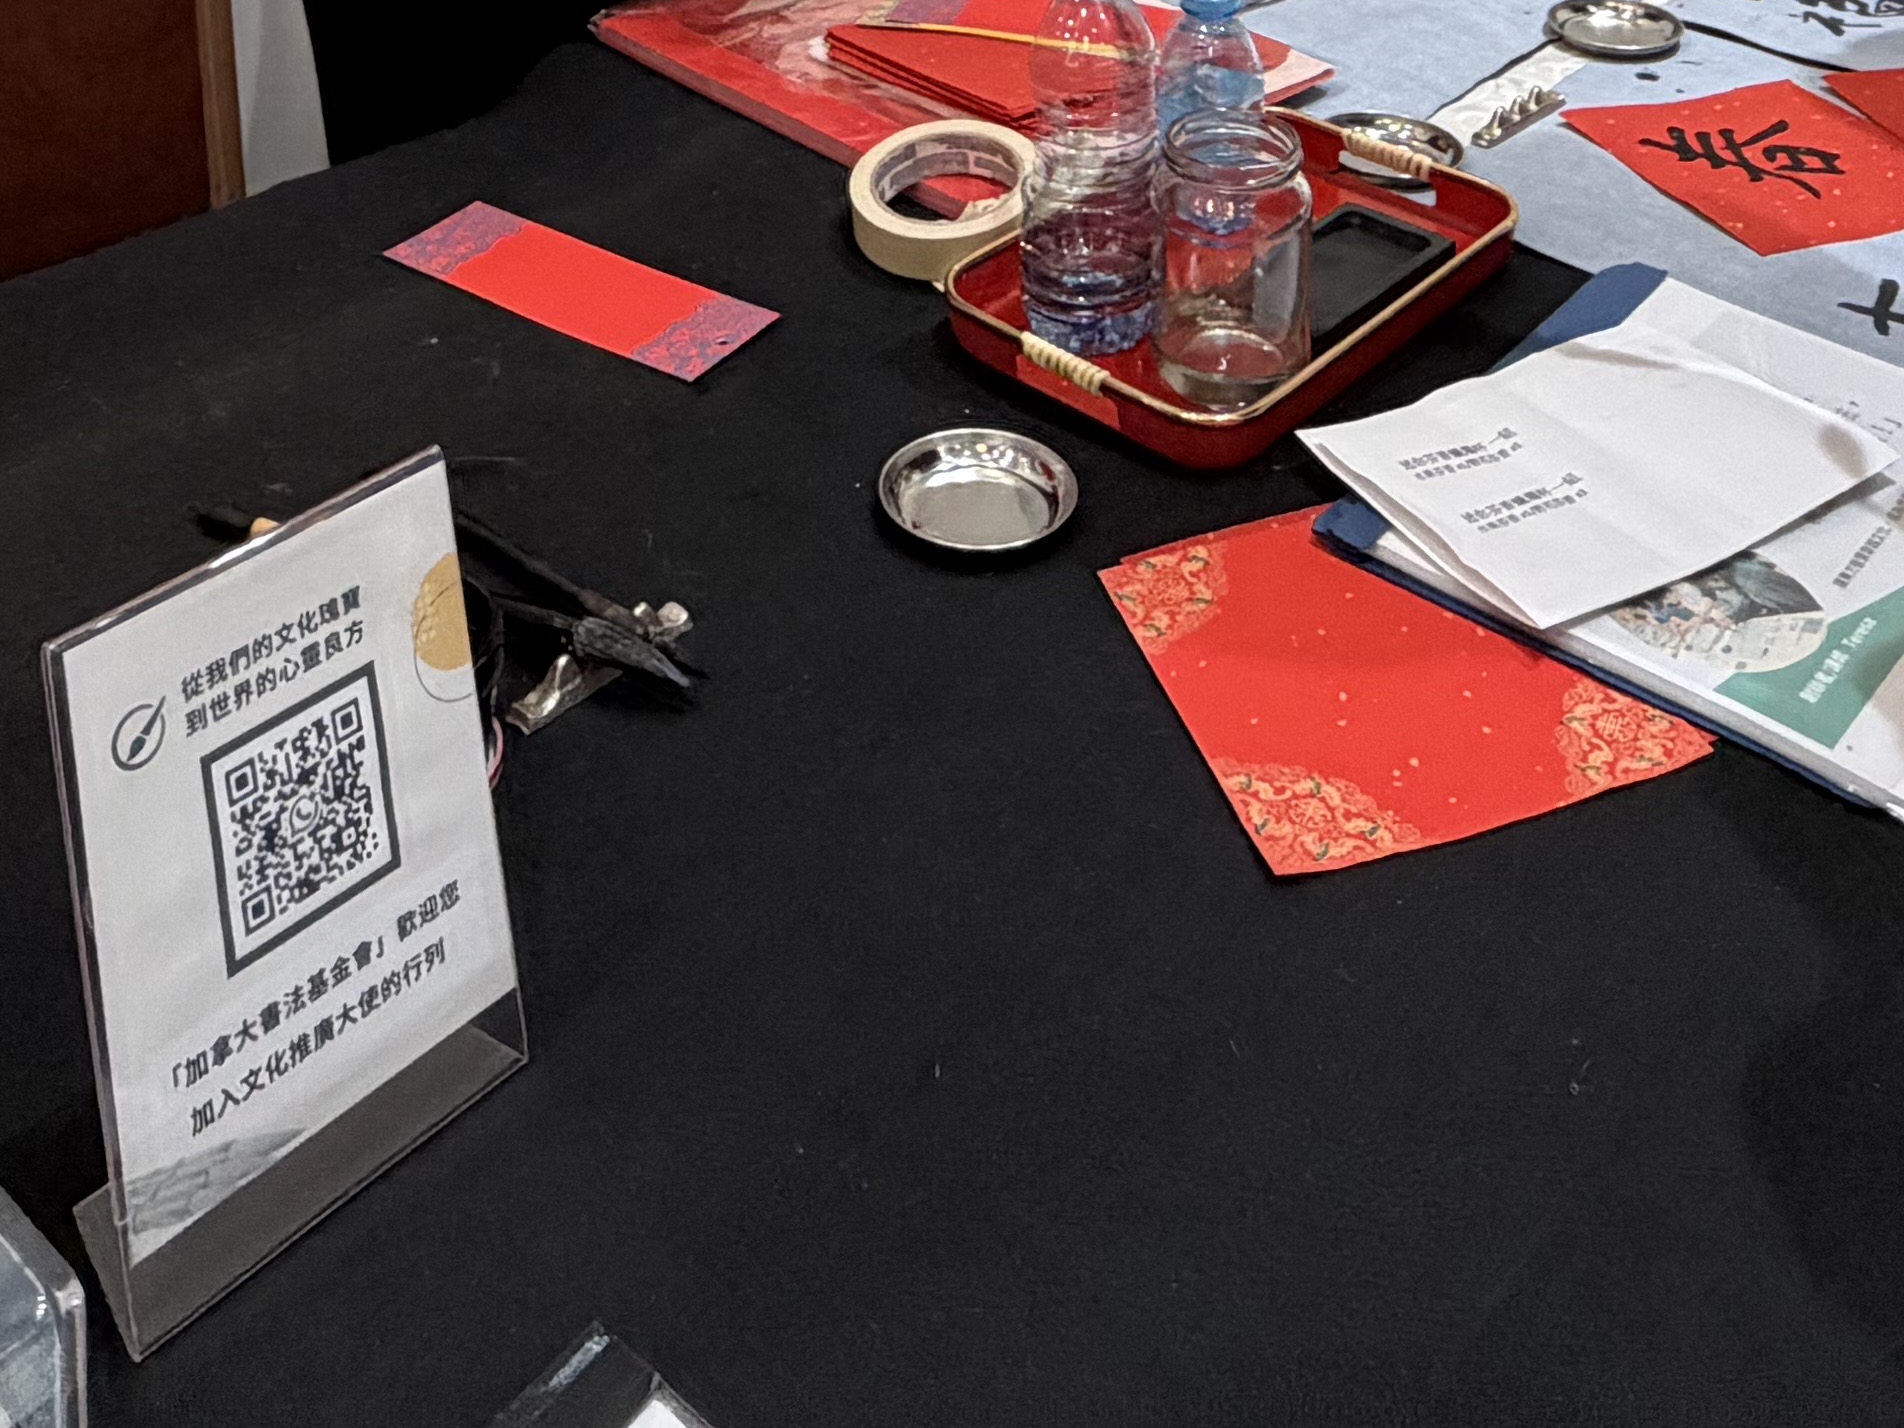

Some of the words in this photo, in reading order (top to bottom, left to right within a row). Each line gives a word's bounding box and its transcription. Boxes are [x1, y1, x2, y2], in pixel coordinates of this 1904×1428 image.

[1638, 120, 1846, 199] 春
[185, 620, 364, 738] 到世界的心靈良方
[191, 937, 446, 1137] 加入文化推廣大使的行列
